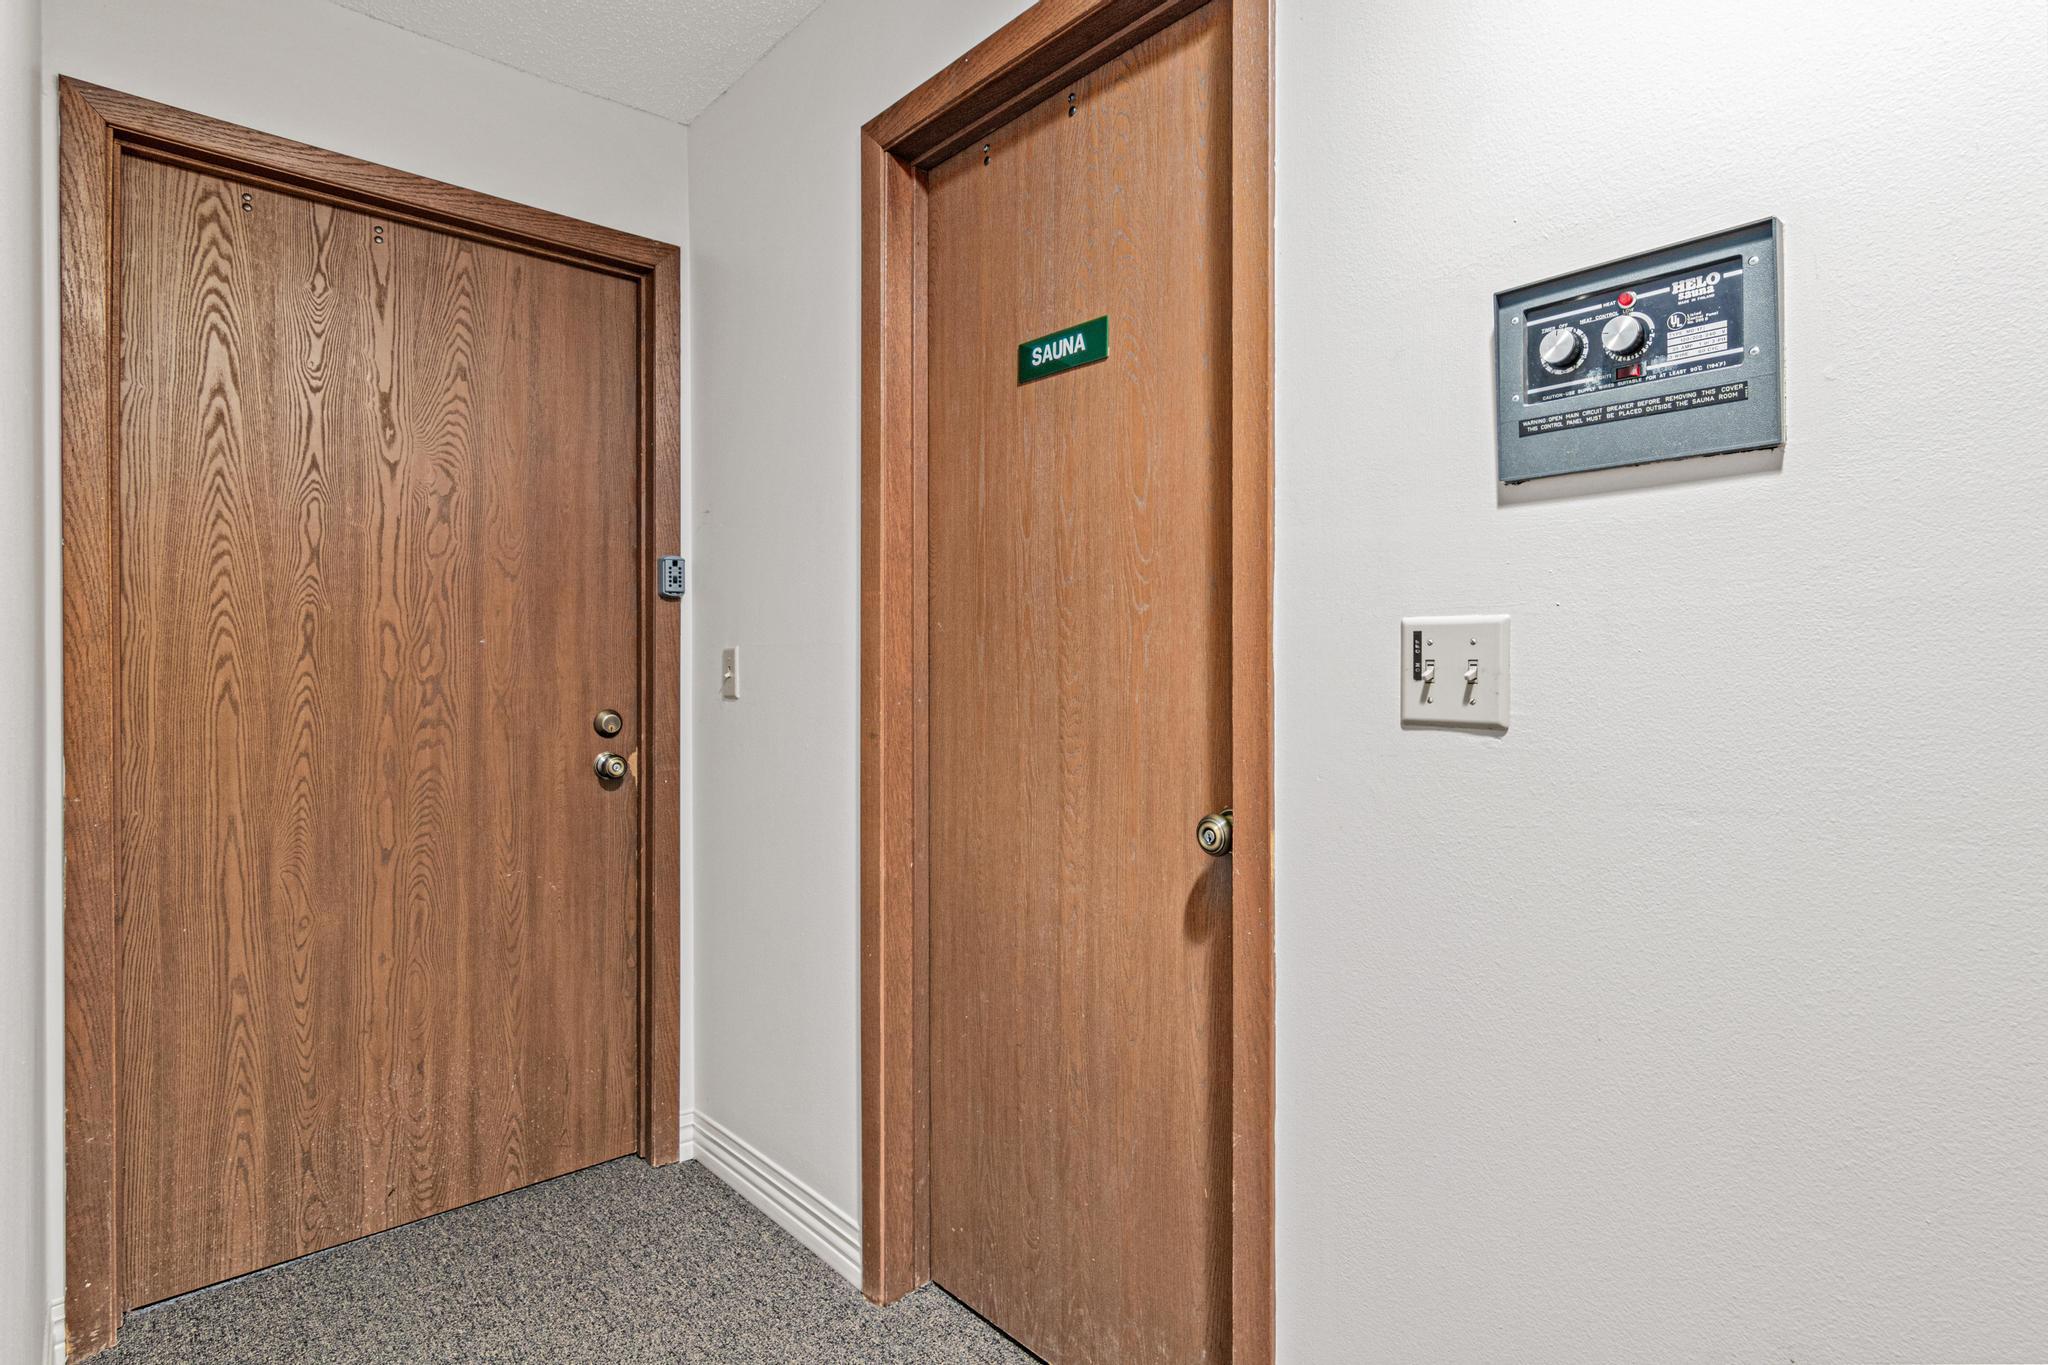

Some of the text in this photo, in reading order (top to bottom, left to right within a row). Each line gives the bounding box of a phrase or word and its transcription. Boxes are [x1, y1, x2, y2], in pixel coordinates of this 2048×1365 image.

[1672, 272, 1720, 295] HELO
[1678, 285, 1715, 300] sauna
[1580, 311, 1618, 325] HEAT CONTROL
[1031, 333, 1086, 366] SAUNA
[1577, 386, 1596, 394] SUPPLY
[1617, 377, 1642, 386] SUITABLE
[1669, 368, 1687, 377] LEAST
[1540, 421, 1563, 430] CONTROL
[1566, 418, 1583, 426] PANEL
[1586, 414, 1602, 422] MUST
[1618, 407, 1643, 417] PLACED
[1645, 402, 1672, 412] OUTSIDE
[1692, 396, 1715, 405] SAUNA
[1719, 391, 1738, 400] ROOM
[1548, 415, 1563, 423] OPEN
[1565, 411, 1580, 419] MAIN
[1582, 407, 1603, 416] CIRCUIT
[1606, 402, 1635, 412] BREAKER
[1637, 397, 1661, 407] BEFORE
[1664, 391, 1697, 402] REMOVING
[1721, 383, 1744, 393] COVER
